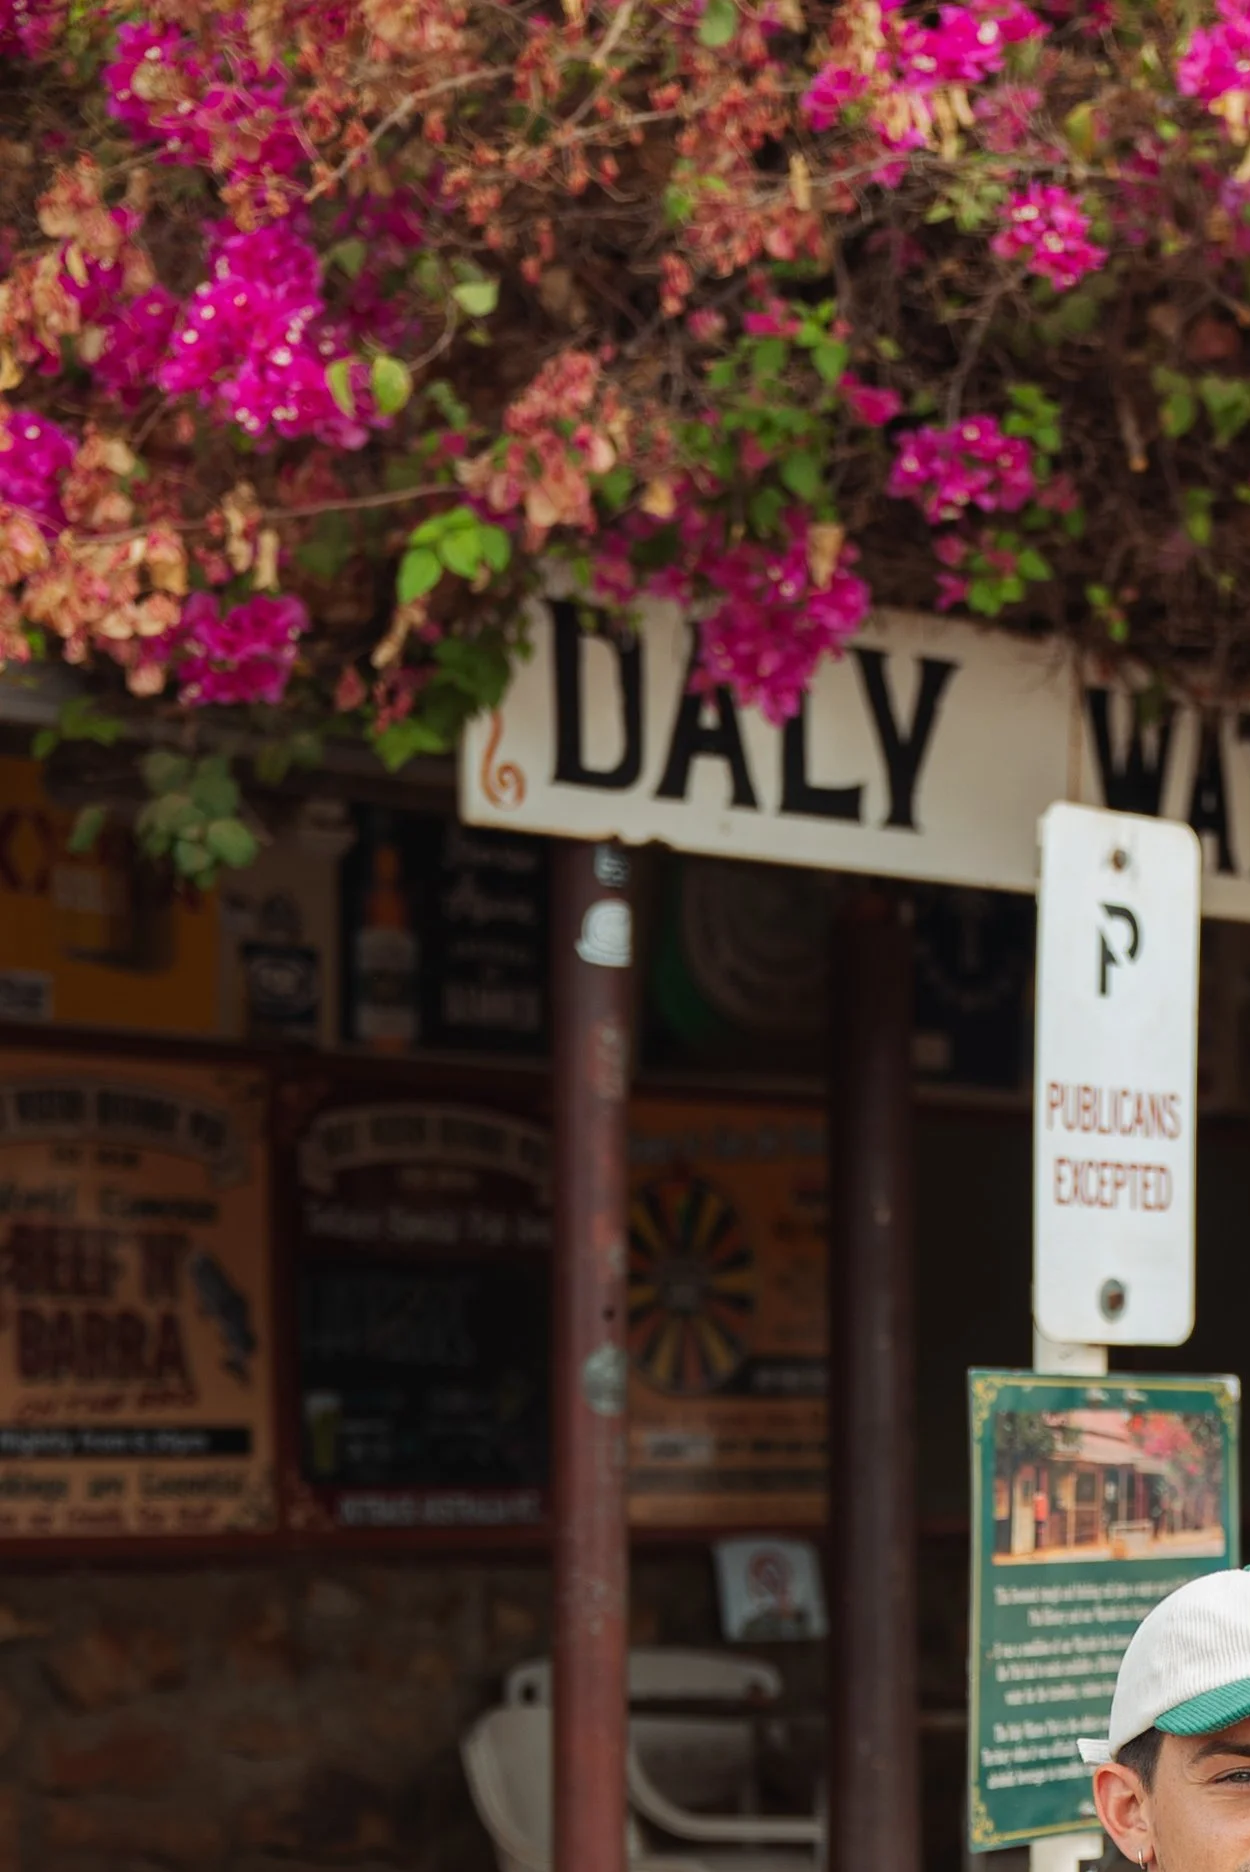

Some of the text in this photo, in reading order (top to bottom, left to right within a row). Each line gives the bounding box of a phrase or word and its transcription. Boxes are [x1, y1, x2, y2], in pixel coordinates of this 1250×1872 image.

[550, 600, 958, 833] DALY
[1046, 1081, 1182, 1142] PUBLICANS
[1053, 1156, 1174, 1212] EXCEPTED
